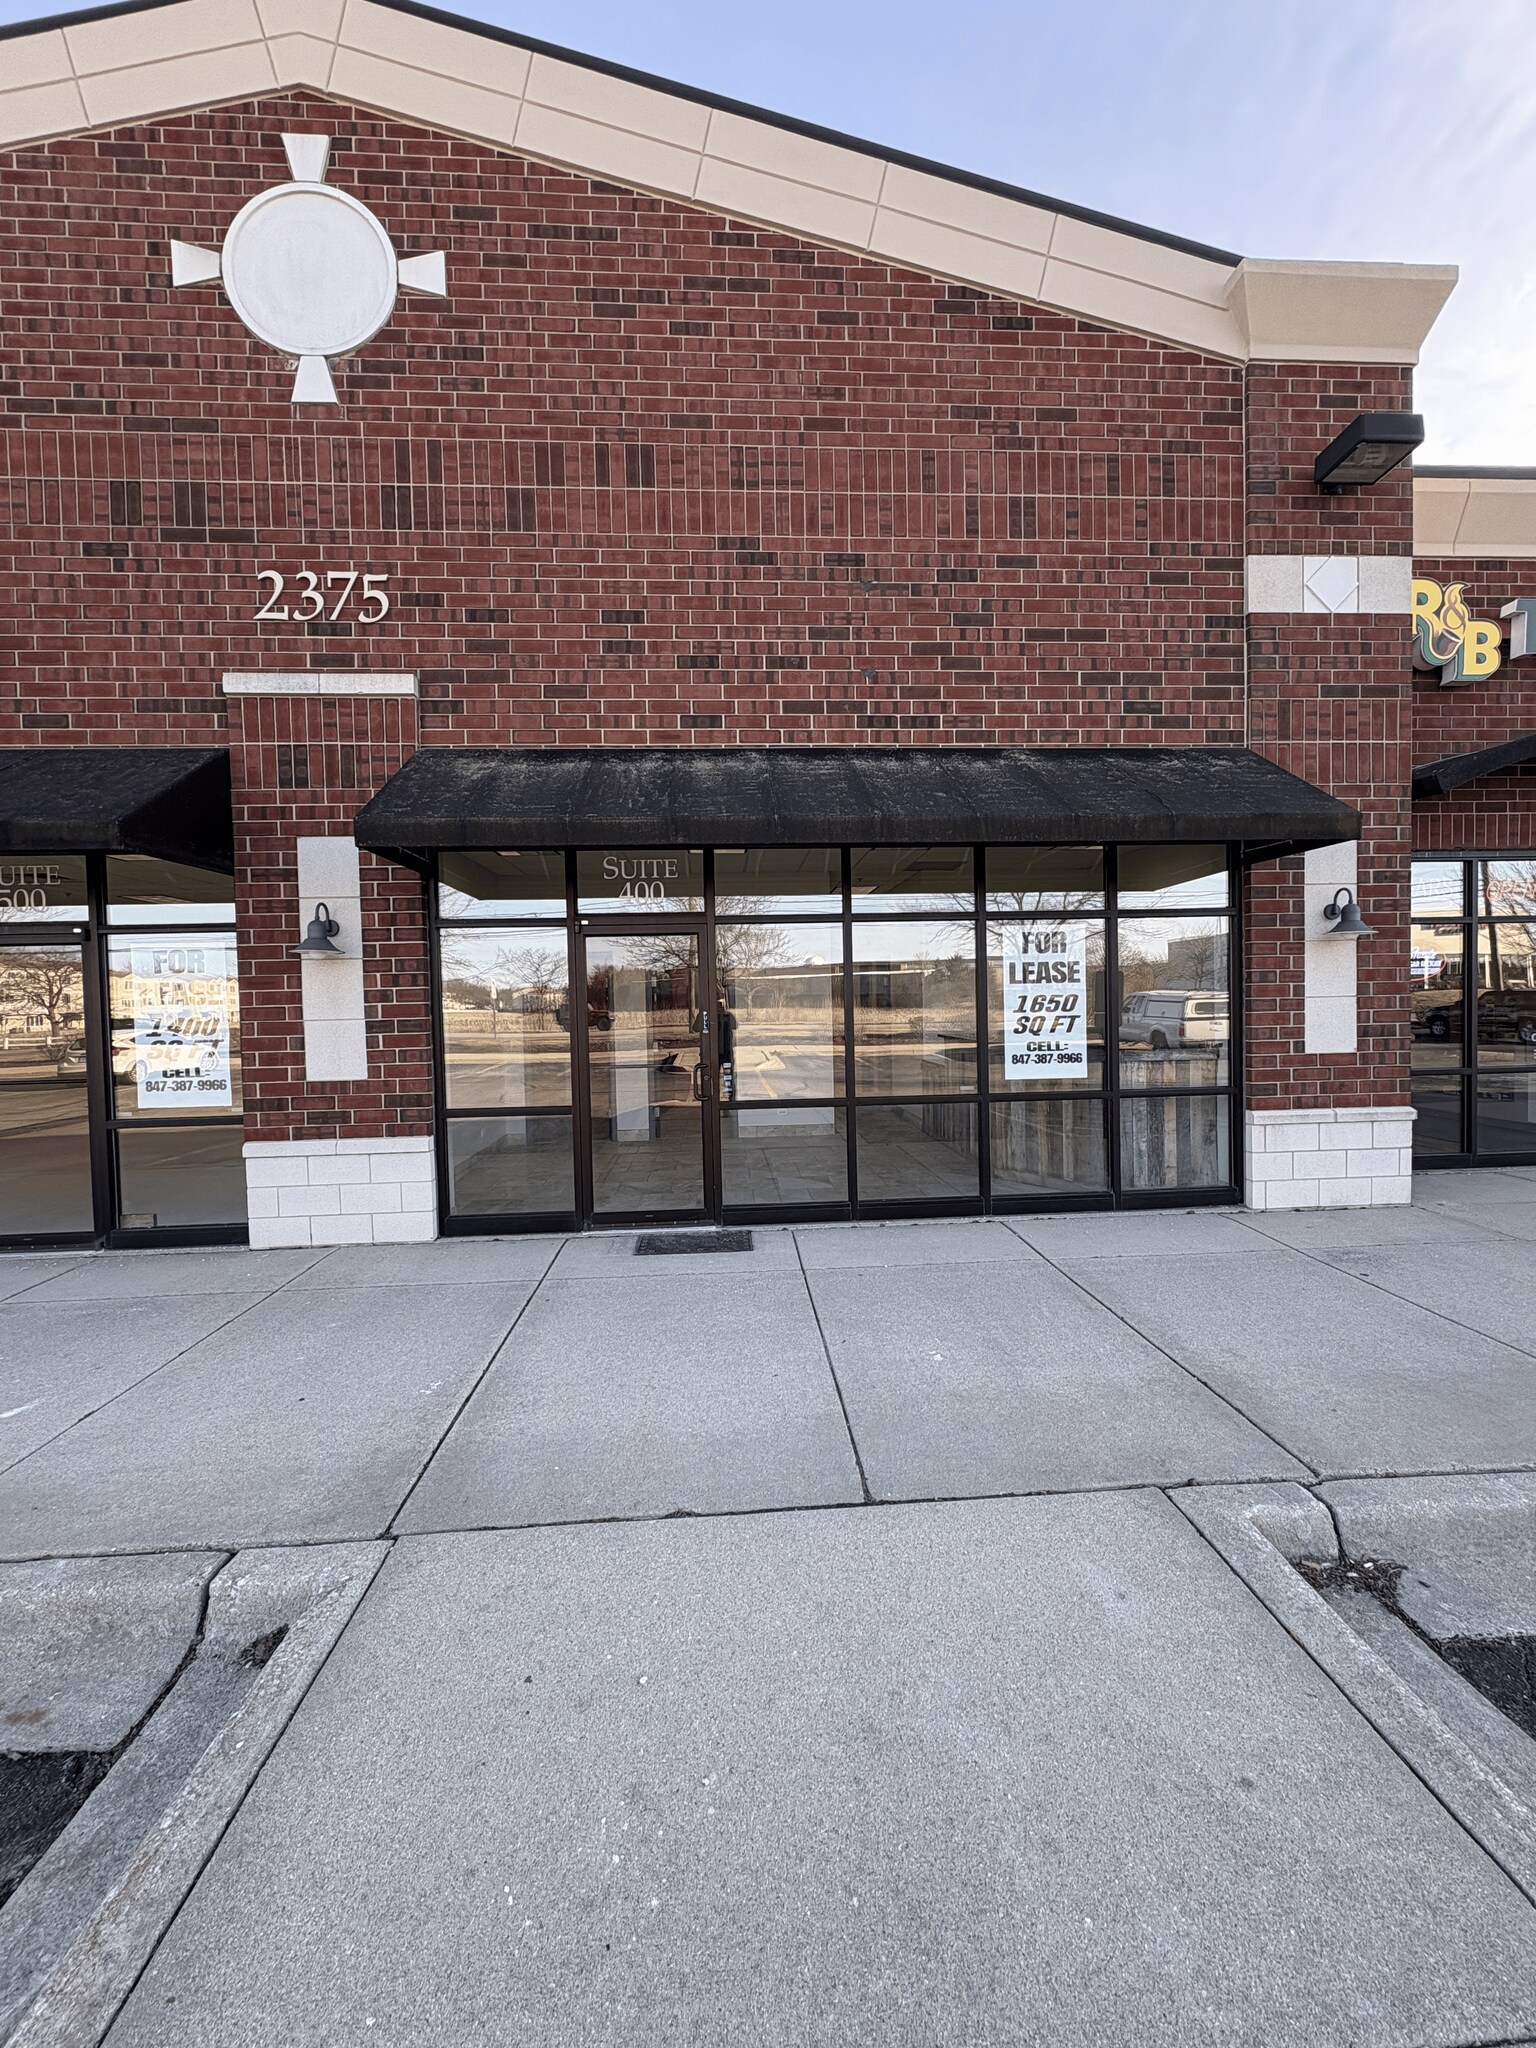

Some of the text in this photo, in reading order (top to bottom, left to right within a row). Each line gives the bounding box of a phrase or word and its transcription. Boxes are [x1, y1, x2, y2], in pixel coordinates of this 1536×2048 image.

[253, 569, 389, 624] 2375
[1411, 577, 1502, 681] R&B
[603, 856, 678, 879] SUITE
[0, 888, 47, 913] 500
[619, 881, 665, 904] 400
[1022, 931, 1067, 954] FOR
[153, 949, 205, 974] FOR
[1009, 961, 1081, 984] LEASE
[141, 981, 223, 1006] EAS
[1013, 994, 1079, 1014] 1650
[1013, 1015, 1081, 1036] SQ FT
[146, 1039, 184, 1061] SQ
[1026, 1041, 1069, 1052] CELL:
[1011, 1053, 1083, 1065] 847-387-9966
[145, 1080, 227, 1093] 847-387-9966
